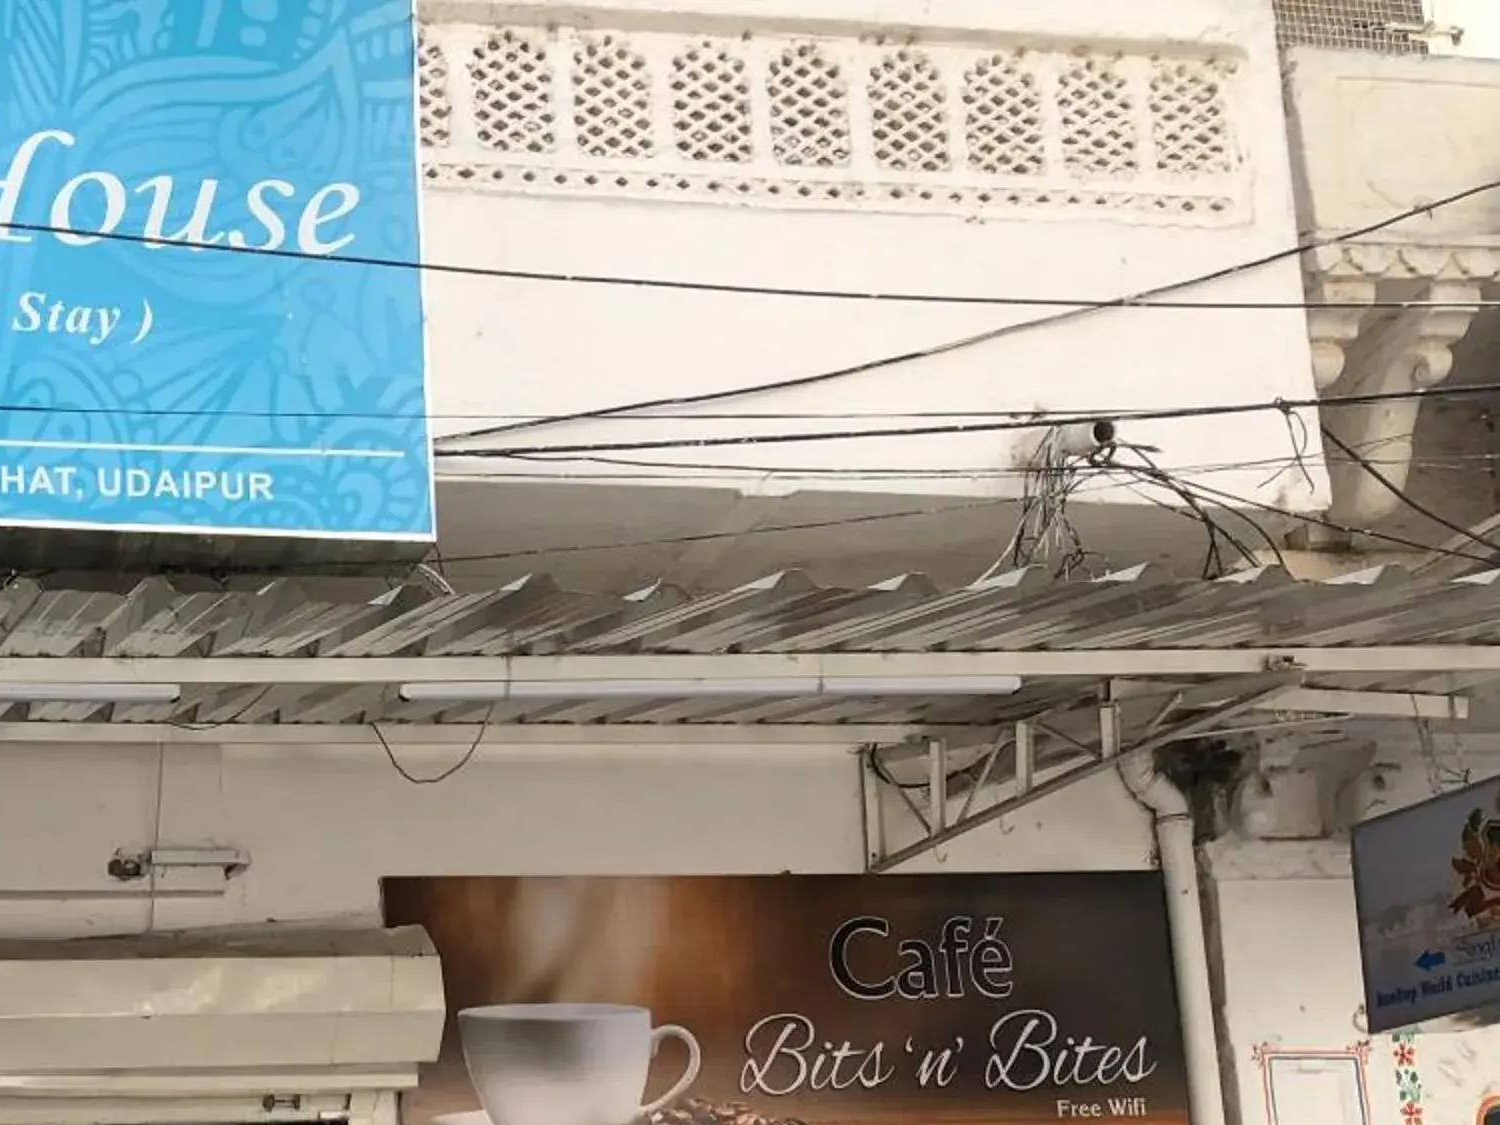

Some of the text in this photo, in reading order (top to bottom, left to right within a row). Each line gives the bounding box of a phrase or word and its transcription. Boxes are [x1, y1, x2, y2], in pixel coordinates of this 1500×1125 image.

[11, 291, 121, 345] Stay
[97, 468, 275, 500] UDAIPUR
[828, 915, 1014, 1000] Café
[740, 1013, 896, 1096] Bits
[985, 1008, 1157, 1091] Bites
[1057, 1098, 1147, 1118] Free Wifi
